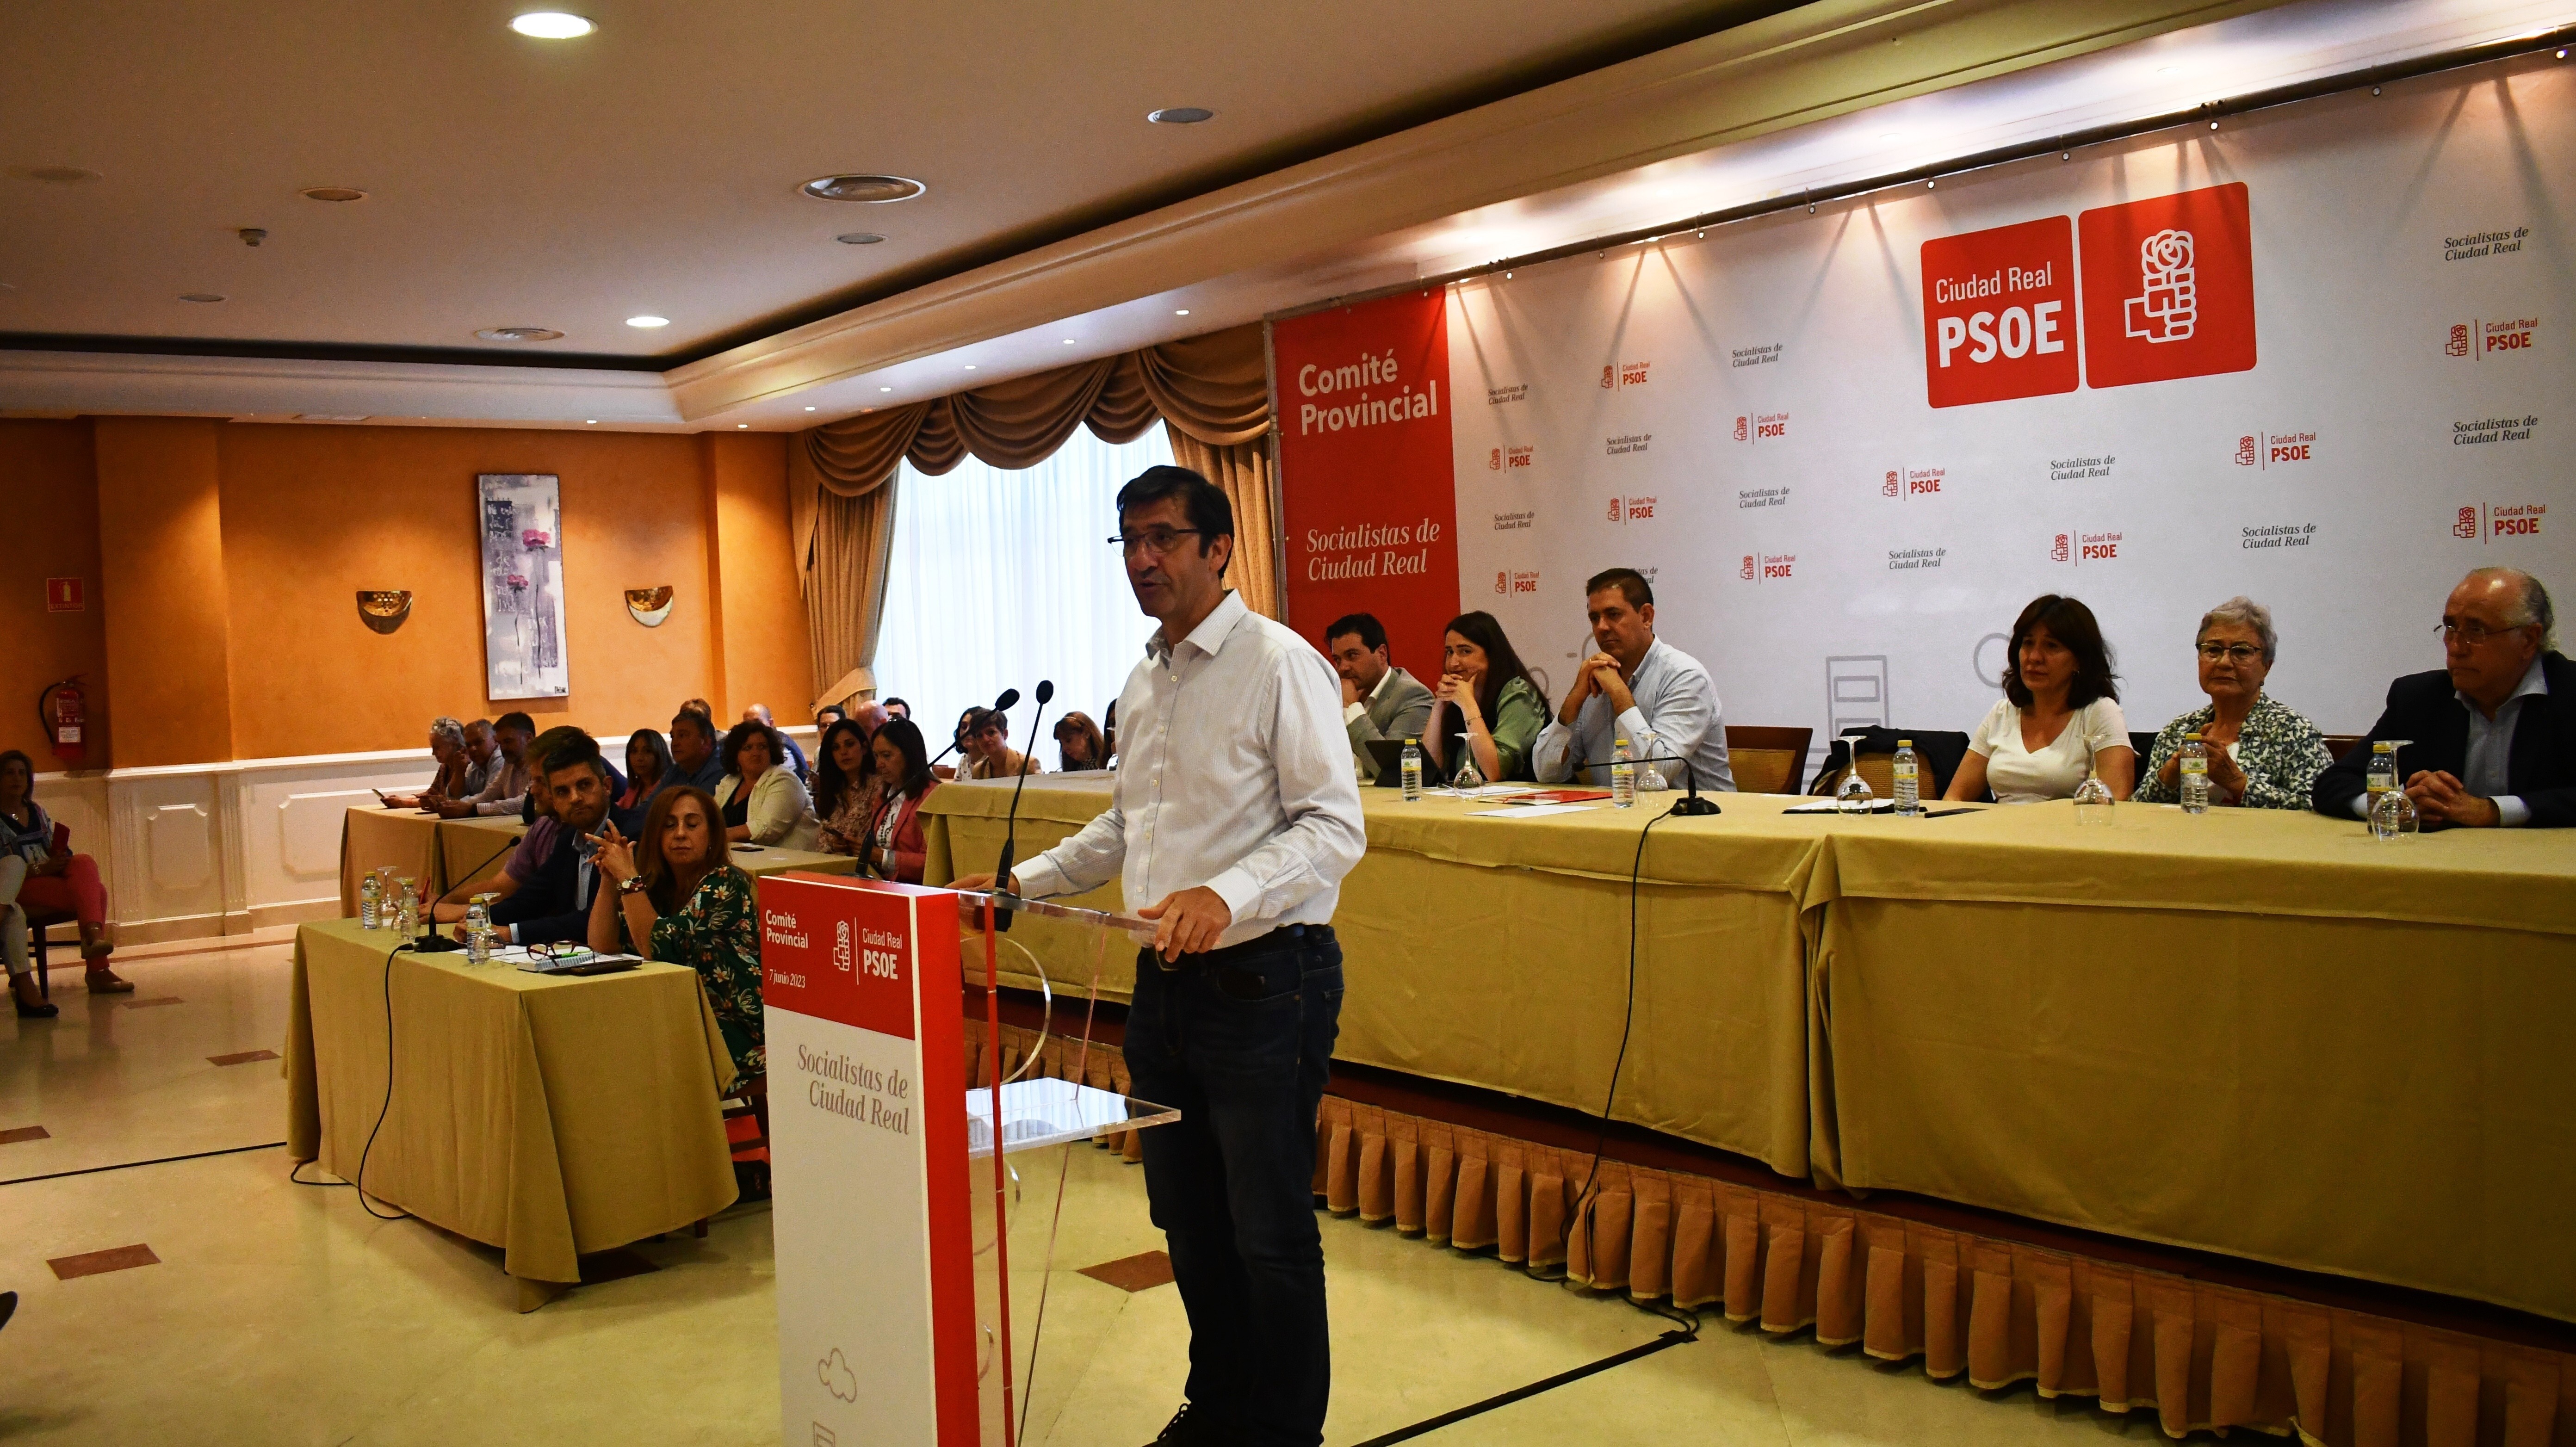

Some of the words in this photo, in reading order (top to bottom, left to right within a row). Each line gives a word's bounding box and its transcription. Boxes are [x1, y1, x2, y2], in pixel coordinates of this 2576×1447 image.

[2445, 232, 2510, 248] Socialistas
[2514, 227, 2528, 238] de
[2446, 245, 2489, 261] Ciudad
[2493, 240, 2520, 254] Real
[1937, 270, 2000, 303] Ciudad
[2009, 262, 2051, 291] Real
[2486, 321, 2515, 333] Ciudad
[2519, 318, 2537, 328] Real
[1938, 301, 2063, 367] PSOE
[2487, 332, 2531, 352] PSOE
[1732, 347, 1771, 358] Socialistas
[1733, 356, 1759, 367] Ciudad
[1762, 353, 1778, 363] Real
[1299, 348, 1398, 396] Comité
[1623, 371, 1647, 385] PSOE
[1488, 386, 1519, 396] Socialistas
[1489, 395, 1509, 405] Ciudad
[1512, 392, 1524, 401] Real
[1301, 380, 1437, 435] Provincial
[1758, 414, 1775, 423] Ciudad
[2453, 419, 2519, 432] Socialistas
[2523, 415, 2538, 426] de
[1759, 423, 1784, 438] PSOE
[2454, 431, 2498, 445] Ciudad
[2502, 428, 2530, 440] Real
[1607, 436, 1641, 445] Socialistas
[2271, 434, 2296, 444] Ciudad
[2299, 432, 2316, 441] Real
[1607, 445, 1630, 455] Ciudad
[1633, 443, 1647, 451] Real
[2272, 445, 2310, 462] PSOE
[1509, 455, 1530, 467] PSOE
[2051, 458, 2100, 469] Socialistas
[2104, 455, 2115, 464] de
[1910, 469, 1930, 478] Ciudad
[1932, 468, 1944, 476] Real
[2051, 469, 2085, 480] Ciudad
[2088, 466, 2109, 477] Real
[1911, 479, 1940, 494] PSOE
[1740, 489, 1778, 499] Socialistas
[1740, 499, 1766, 508] Ciudad
[1769, 497, 1785, 506] Real
[1494, 513, 1525, 521] Socialistas
[1629, 506, 1653, 519] PSOE
[2495, 506, 2523, 516] Ciudad
[2527, 504, 2545, 514] Real
[1494, 521, 1516, 530] Ciudad
[2242, 526, 2299, 537] Socialistas
[2304, 523, 2316, 533] de
[2495, 518, 2539, 536] PSOE
[1307, 523, 1409, 552] Socialistas
[1417, 518, 1439, 542] de
[2083, 534, 2105, 542] Ciudad
[2243, 537, 2281, 549] Ciudad
[2285, 536, 2309, 546] Real
[1889, 550, 1933, 559] Socialistas
[1936, 548, 1946, 556] de
[2083, 544, 2117, 559] PSOE
[1309, 553, 1375, 581] Ciudad
[1381, 549, 1426, 575] Real
[1889, 560, 1919, 569] Ciudad
[1922, 558, 1940, 567] Real
[1765, 565, 1791, 577] PSOE
[1515, 581, 1536, 592] PSOE
[766, 909, 796, 928] Comité
[767, 928, 808, 948] Provincial
[863, 928, 885, 946] Ciudad
[887, 933, 902, 948] Real
[864, 949, 898, 979] PSOE
[769, 969, 774, 981] 7
[773, 970, 789, 984] junio
[790, 973, 805, 988] 2023
[798, 1045, 882, 1092] Socialistas
[888, 1070, 907, 1099] de
[810, 1081, 865, 1121] Ciudad
[871, 1098, 909, 1135] Real
